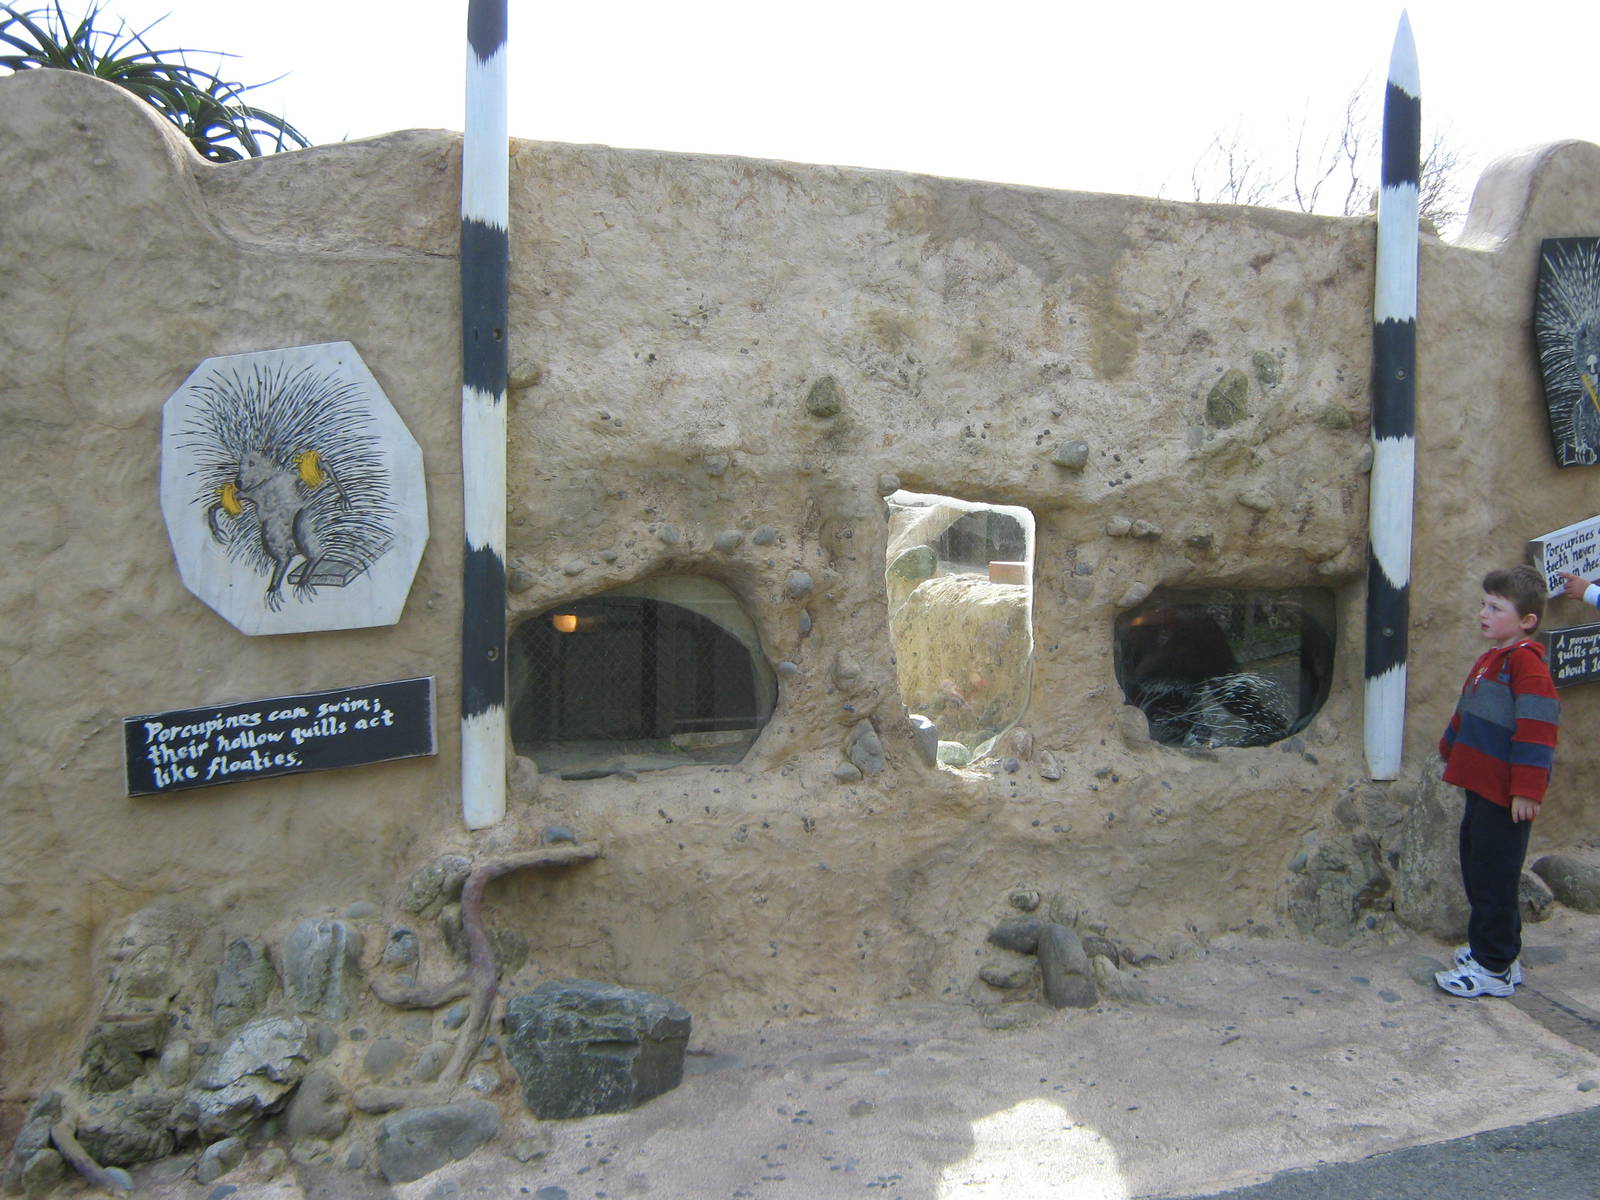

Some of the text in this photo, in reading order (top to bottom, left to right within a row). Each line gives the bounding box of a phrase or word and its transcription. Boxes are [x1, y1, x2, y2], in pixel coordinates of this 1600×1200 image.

[1546, 529, 1594, 558] Porcupines
[1546, 543, 1597, 574] teeth never
[1572, 565, 1581, 577] in
[1582, 557, 1600, 573] chec
[1556, 633, 1600, 650] A porcup
[1557, 646, 1586, 665] quills
[1558, 659, 1586, 679] about
[143, 712, 262, 744] Porcupines
[267, 706, 309, 722] can
[146, 709, 395, 766] their hollow quills act
[153, 763, 200, 789] like
